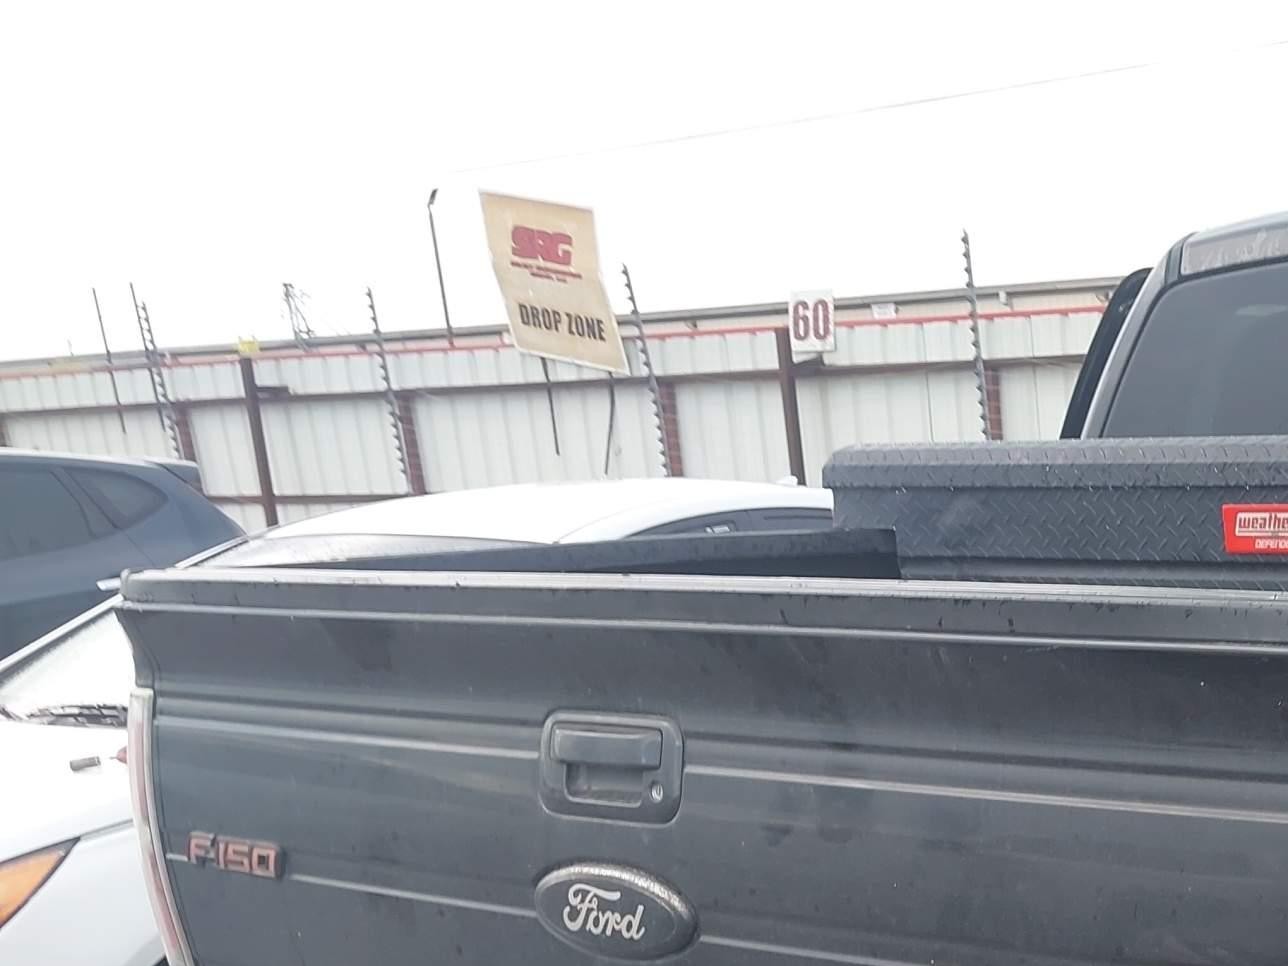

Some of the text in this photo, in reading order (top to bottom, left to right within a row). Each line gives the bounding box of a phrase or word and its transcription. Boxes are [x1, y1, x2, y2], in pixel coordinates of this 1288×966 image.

[518, 302, 606, 341] DROP ZONE
[793, 299, 830, 341] 60
[563, 883, 646, 940] Ford
